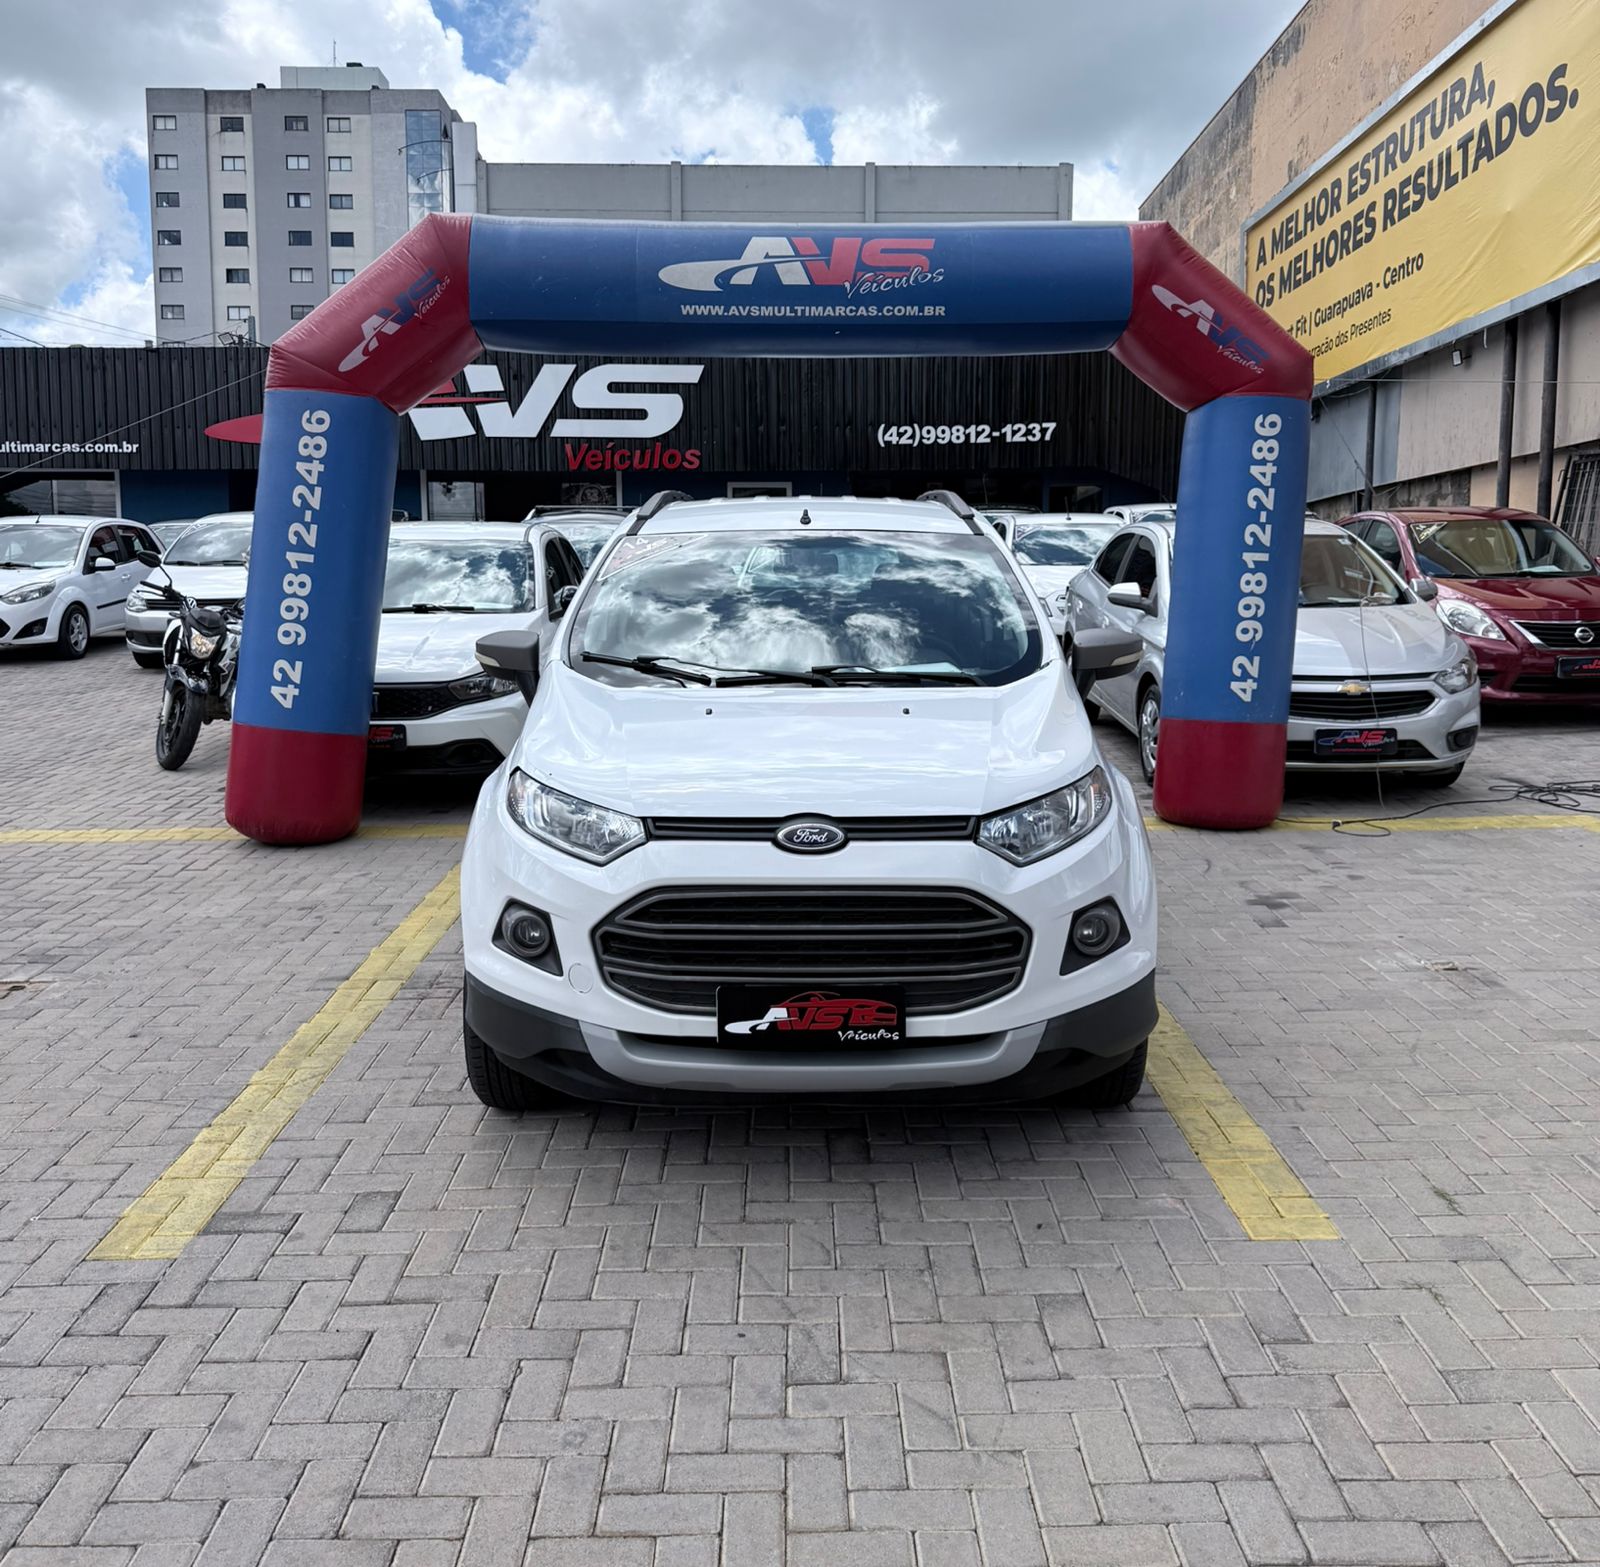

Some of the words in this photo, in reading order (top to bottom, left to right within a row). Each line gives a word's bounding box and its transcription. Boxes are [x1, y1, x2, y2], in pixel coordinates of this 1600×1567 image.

[1256, 236, 1268, 272] A
[1271, 178, 1342, 261] MELHOR
[1347, 61, 1496, 205] ESTRUTURA,
[1256, 272, 1275, 309] OS
[1279, 201, 1377, 300] MELHORES
[1383, 63, 1579, 233] RESULTADOS.
[727, 236, 936, 286] AVS
[844, 266, 945, 298] Veículos
[1314, 281, 1373, 328] Guarapuava
[1383, 252, 1424, 290] Centro
[681, 304, 945, 316] WWW.AVSMULTIMARCAS.COM.BR
[1350, 308, 1392, 341] Presentes
[877, 422, 1057, 447] (42)99812-1237
[564, 442, 702, 470] Veículos
[277, 408, 331, 646] 99812-2486
[1235, 412, 1282, 643] 99812-2486
[270, 659, 303, 709] 42
[1230, 655, 1260, 703] 42
[793, 828, 829, 843] Ford
[754, 1006, 850, 1031] AVS
[837, 1029, 900, 1041] Veículos
